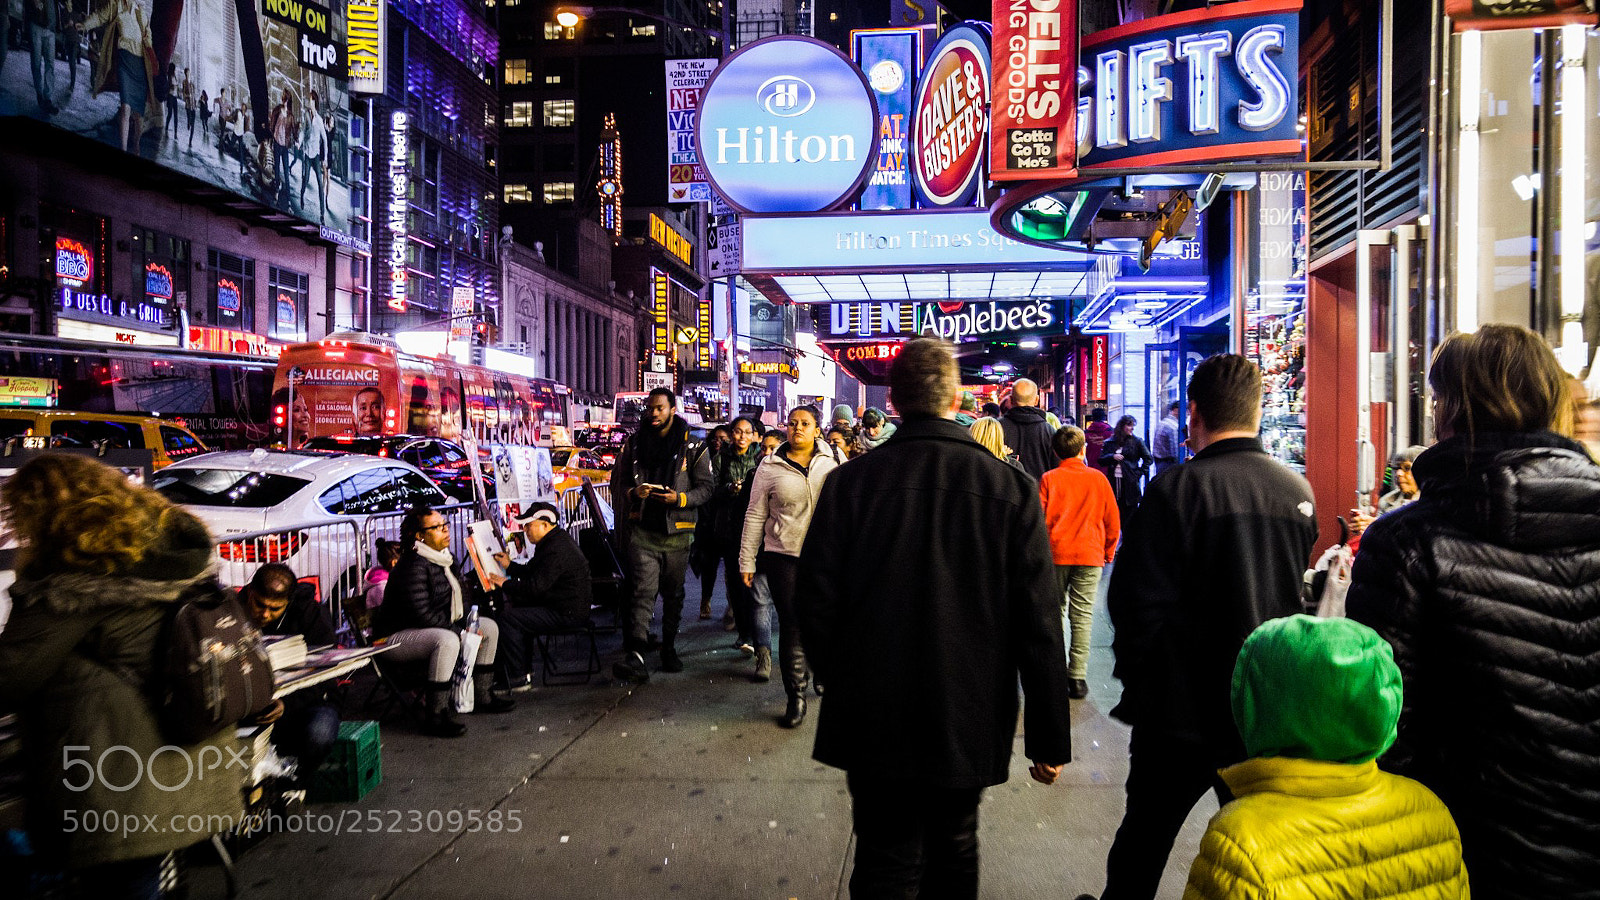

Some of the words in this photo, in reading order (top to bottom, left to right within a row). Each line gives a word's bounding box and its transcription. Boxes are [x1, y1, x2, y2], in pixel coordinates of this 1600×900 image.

[266, 0, 303, 23] NOW
[305, 8, 326, 34] ON
[347, 4, 378, 69] DUKE
[1008, 35, 1027, 118] GOODS
[922, 68, 966, 149] DAVE
[963, 60, 981, 99] &
[716, 126, 856, 163] Hilton
[924, 96, 982, 181] BUSTER'S
[1011, 130, 1054, 143] Gotta
[1011, 144, 1032, 157] Go
[1033, 143, 1051, 156] To
[1018, 157, 1049, 168] Mo's
[672, 165, 692, 183] 20
[321, 230, 352, 247] OUTFRONT
[355, 238, 370, 251] PRIME
[835, 231, 902, 250] Hilton
[907, 230, 972, 249] Times
[59, 250, 85, 261] DALLAS
[57, 257, 88, 278] BBQ
[148, 272, 169, 281] DALLAS
[147, 280, 171, 297] BBQ
[655, 275, 667, 323] VICTORY
[139, 302, 163, 324] GRILL
[454, 299, 473, 308] NEW
[699, 302, 709, 343] VICTORY
[921, 300, 1053, 344] Applebee's
[655, 328, 667, 351] NEW
[699, 347, 709, 367] NEW
[305, 369, 379, 381] ALLEGIANCE
[209, 418, 238, 430] TOWERS
